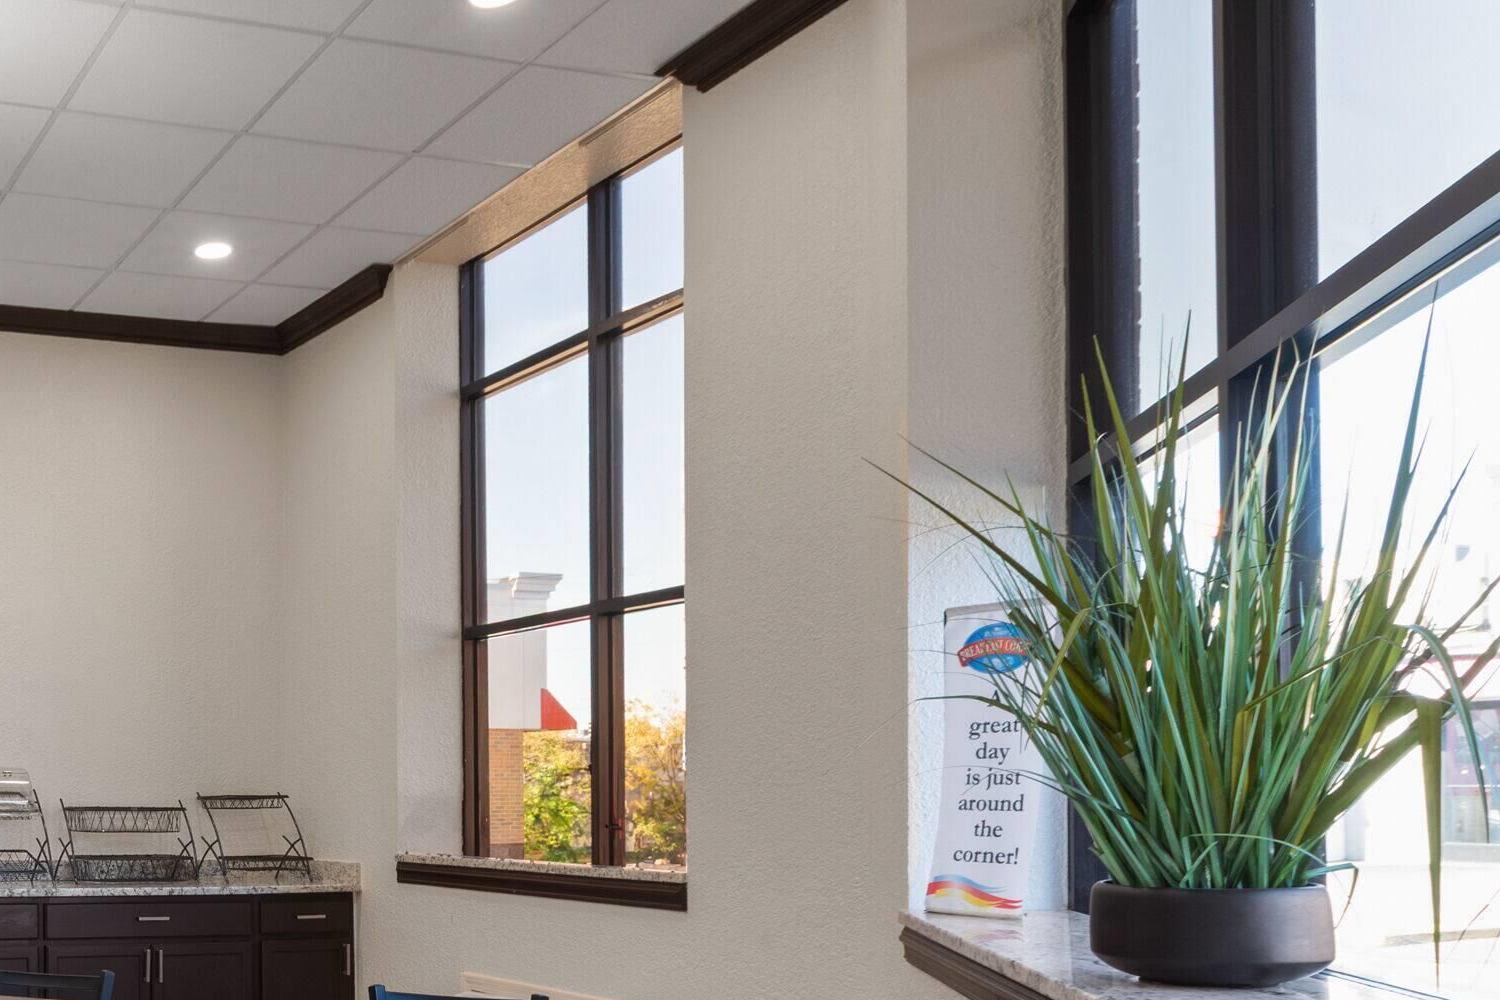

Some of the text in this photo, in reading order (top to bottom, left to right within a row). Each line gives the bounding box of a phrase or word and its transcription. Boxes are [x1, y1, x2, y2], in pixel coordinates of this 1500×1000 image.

[968, 719, 1020, 741] great
[975, 741, 1011, 765] day
[965, 767, 1021, 791] is just
[957, 793, 1025, 812] around
[973, 819, 1003, 838] the
[953, 847, 1020, 865] corner!
